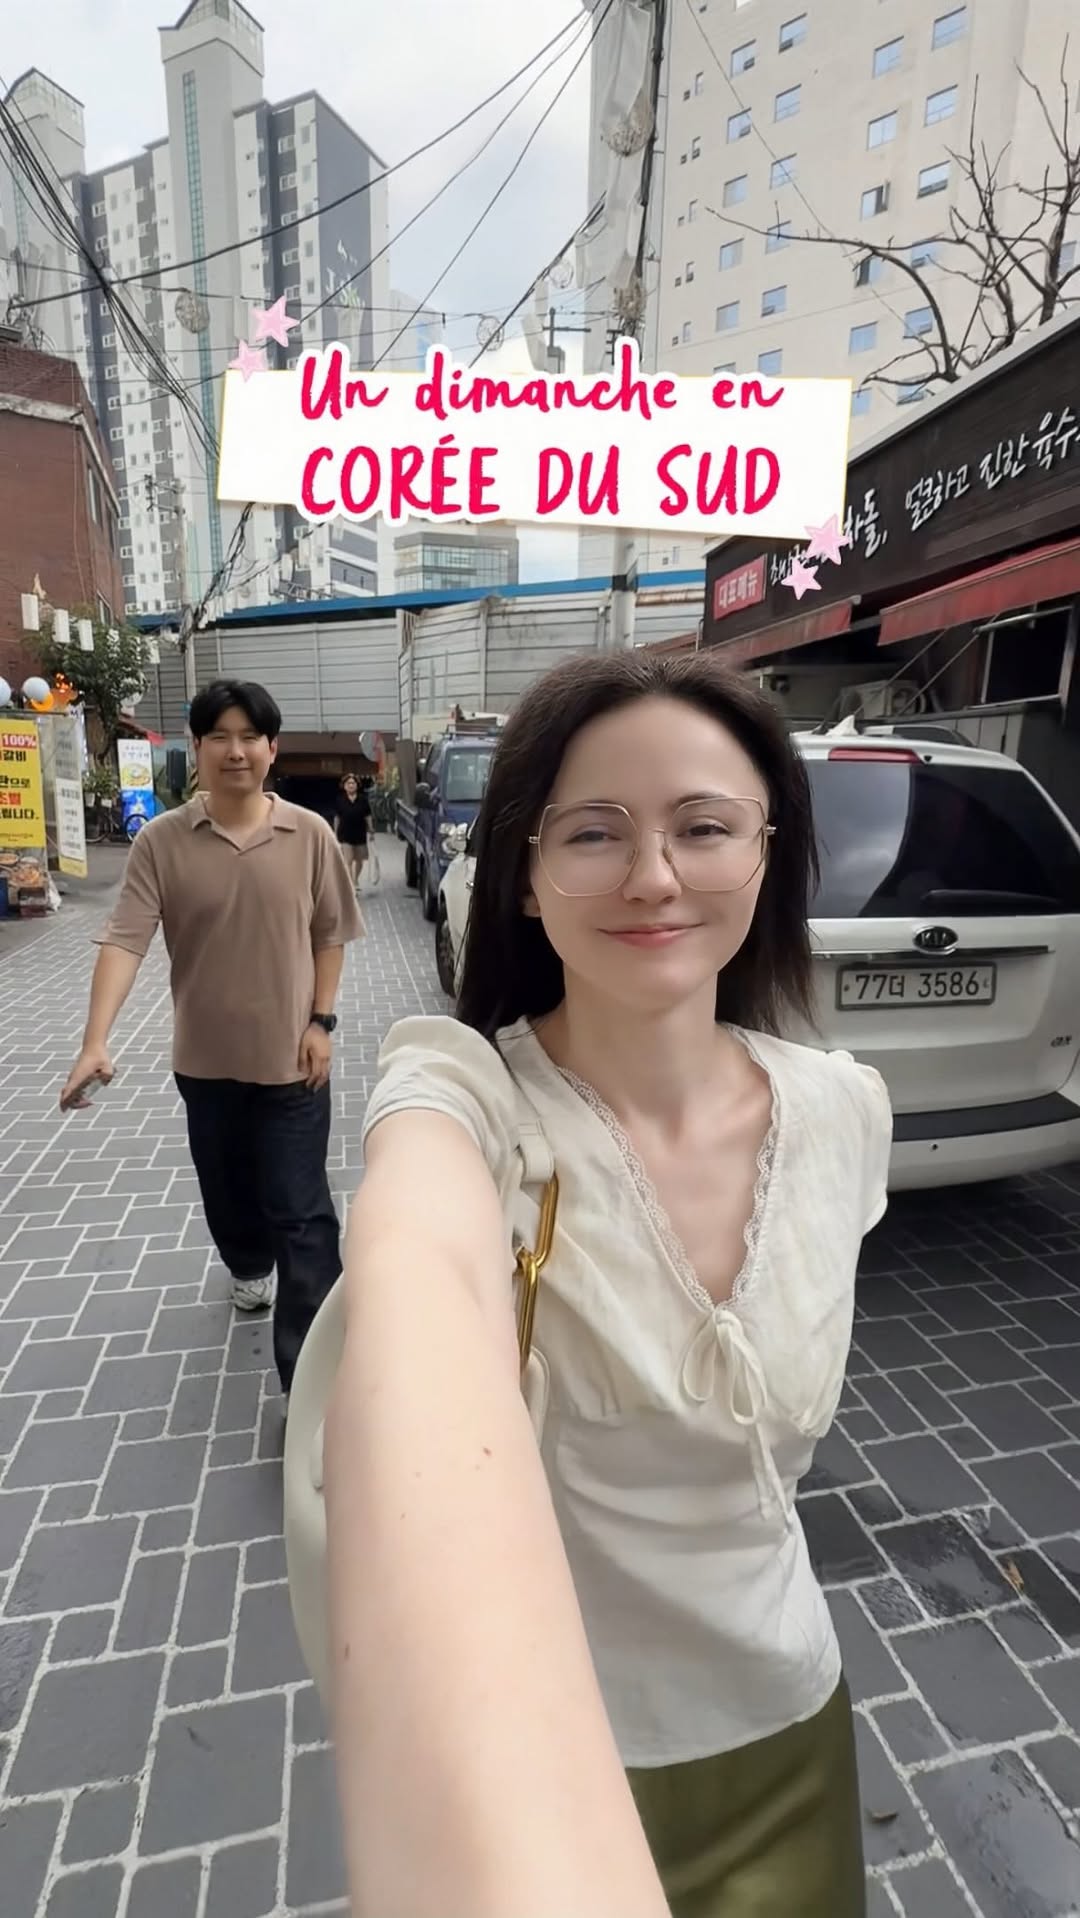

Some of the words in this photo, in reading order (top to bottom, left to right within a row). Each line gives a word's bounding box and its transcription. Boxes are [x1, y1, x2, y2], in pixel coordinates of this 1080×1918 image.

[905, 469, 970, 532] 얼큰하고
[979, 433, 1030, 490] 진한
[1032, 406, 1080, 470] 육수
[719, 569, 759, 609] 대표메뉴
[4, 734, 37, 747] 100%
[921, 931, 952, 946] KIA
[855, 974, 905, 1000] 77더
[918, 970, 979, 998] 3586
